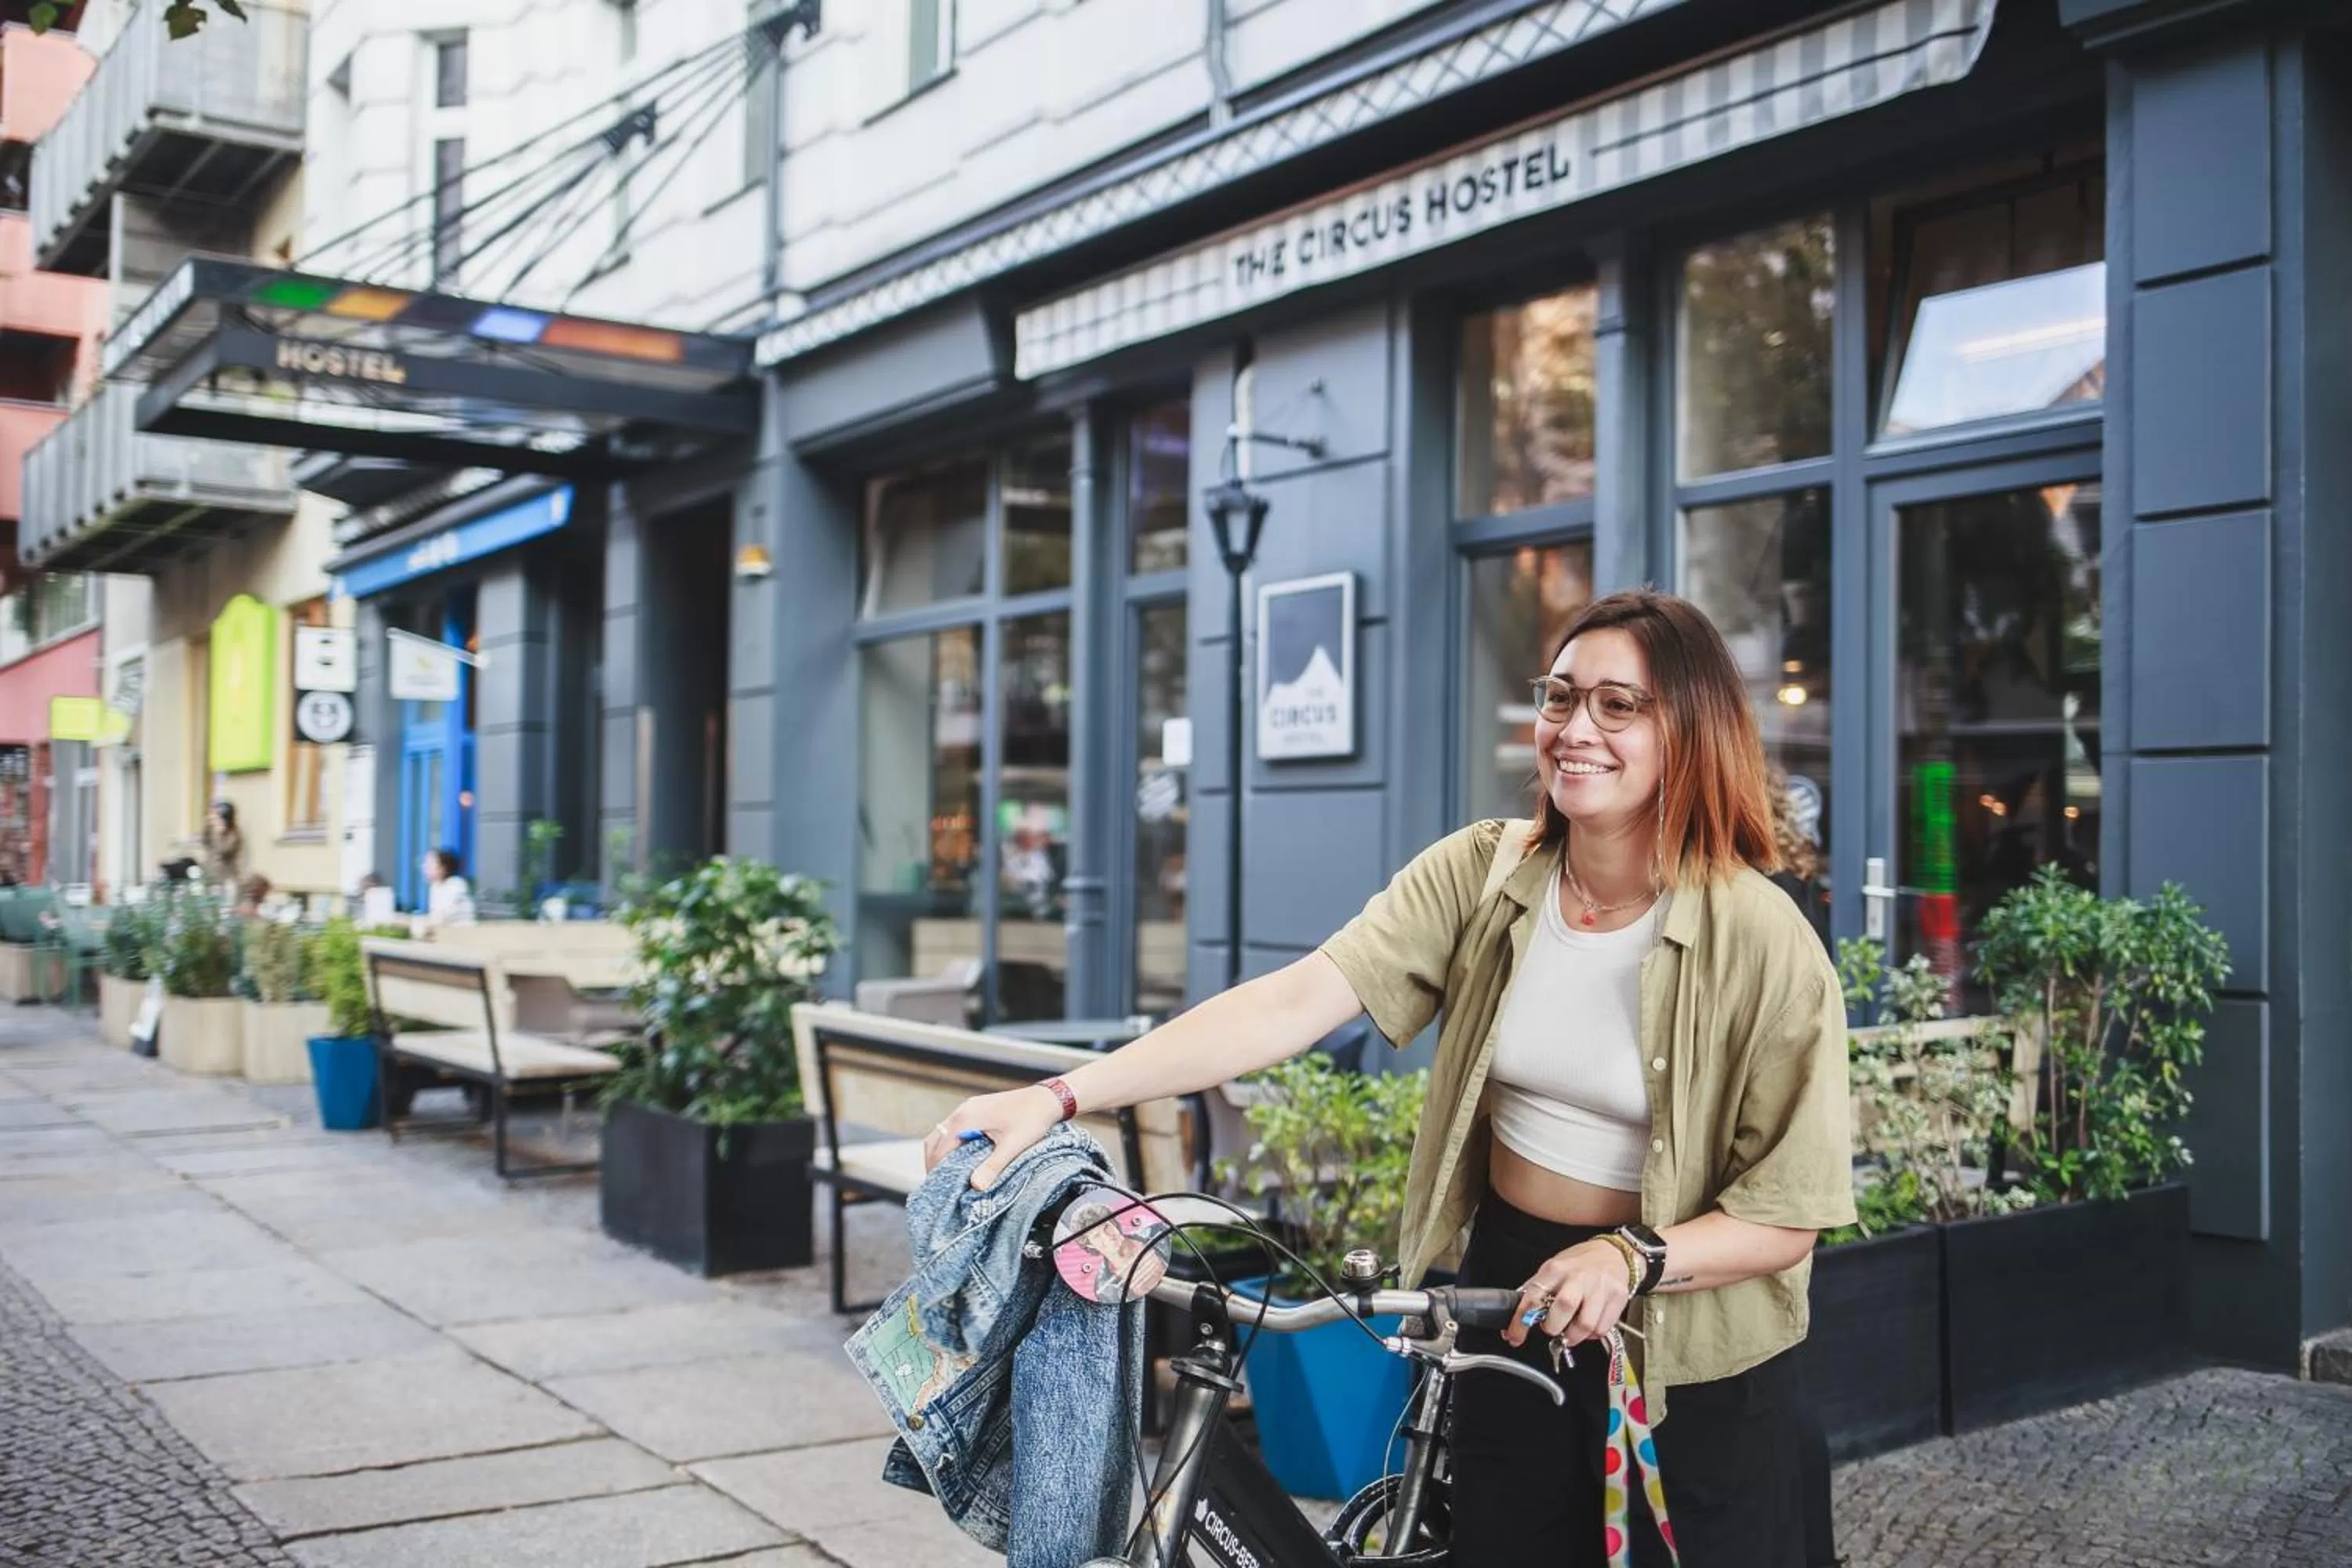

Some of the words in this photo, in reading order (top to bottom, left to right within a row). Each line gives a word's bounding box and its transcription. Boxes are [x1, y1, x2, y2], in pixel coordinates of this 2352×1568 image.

[1231, 245, 1287, 285] THE
[1297, 198, 1411, 265] CIRCUS
[1425, 142, 1570, 224] HOSTEL
[277, 339, 406, 384] HOSTEL
